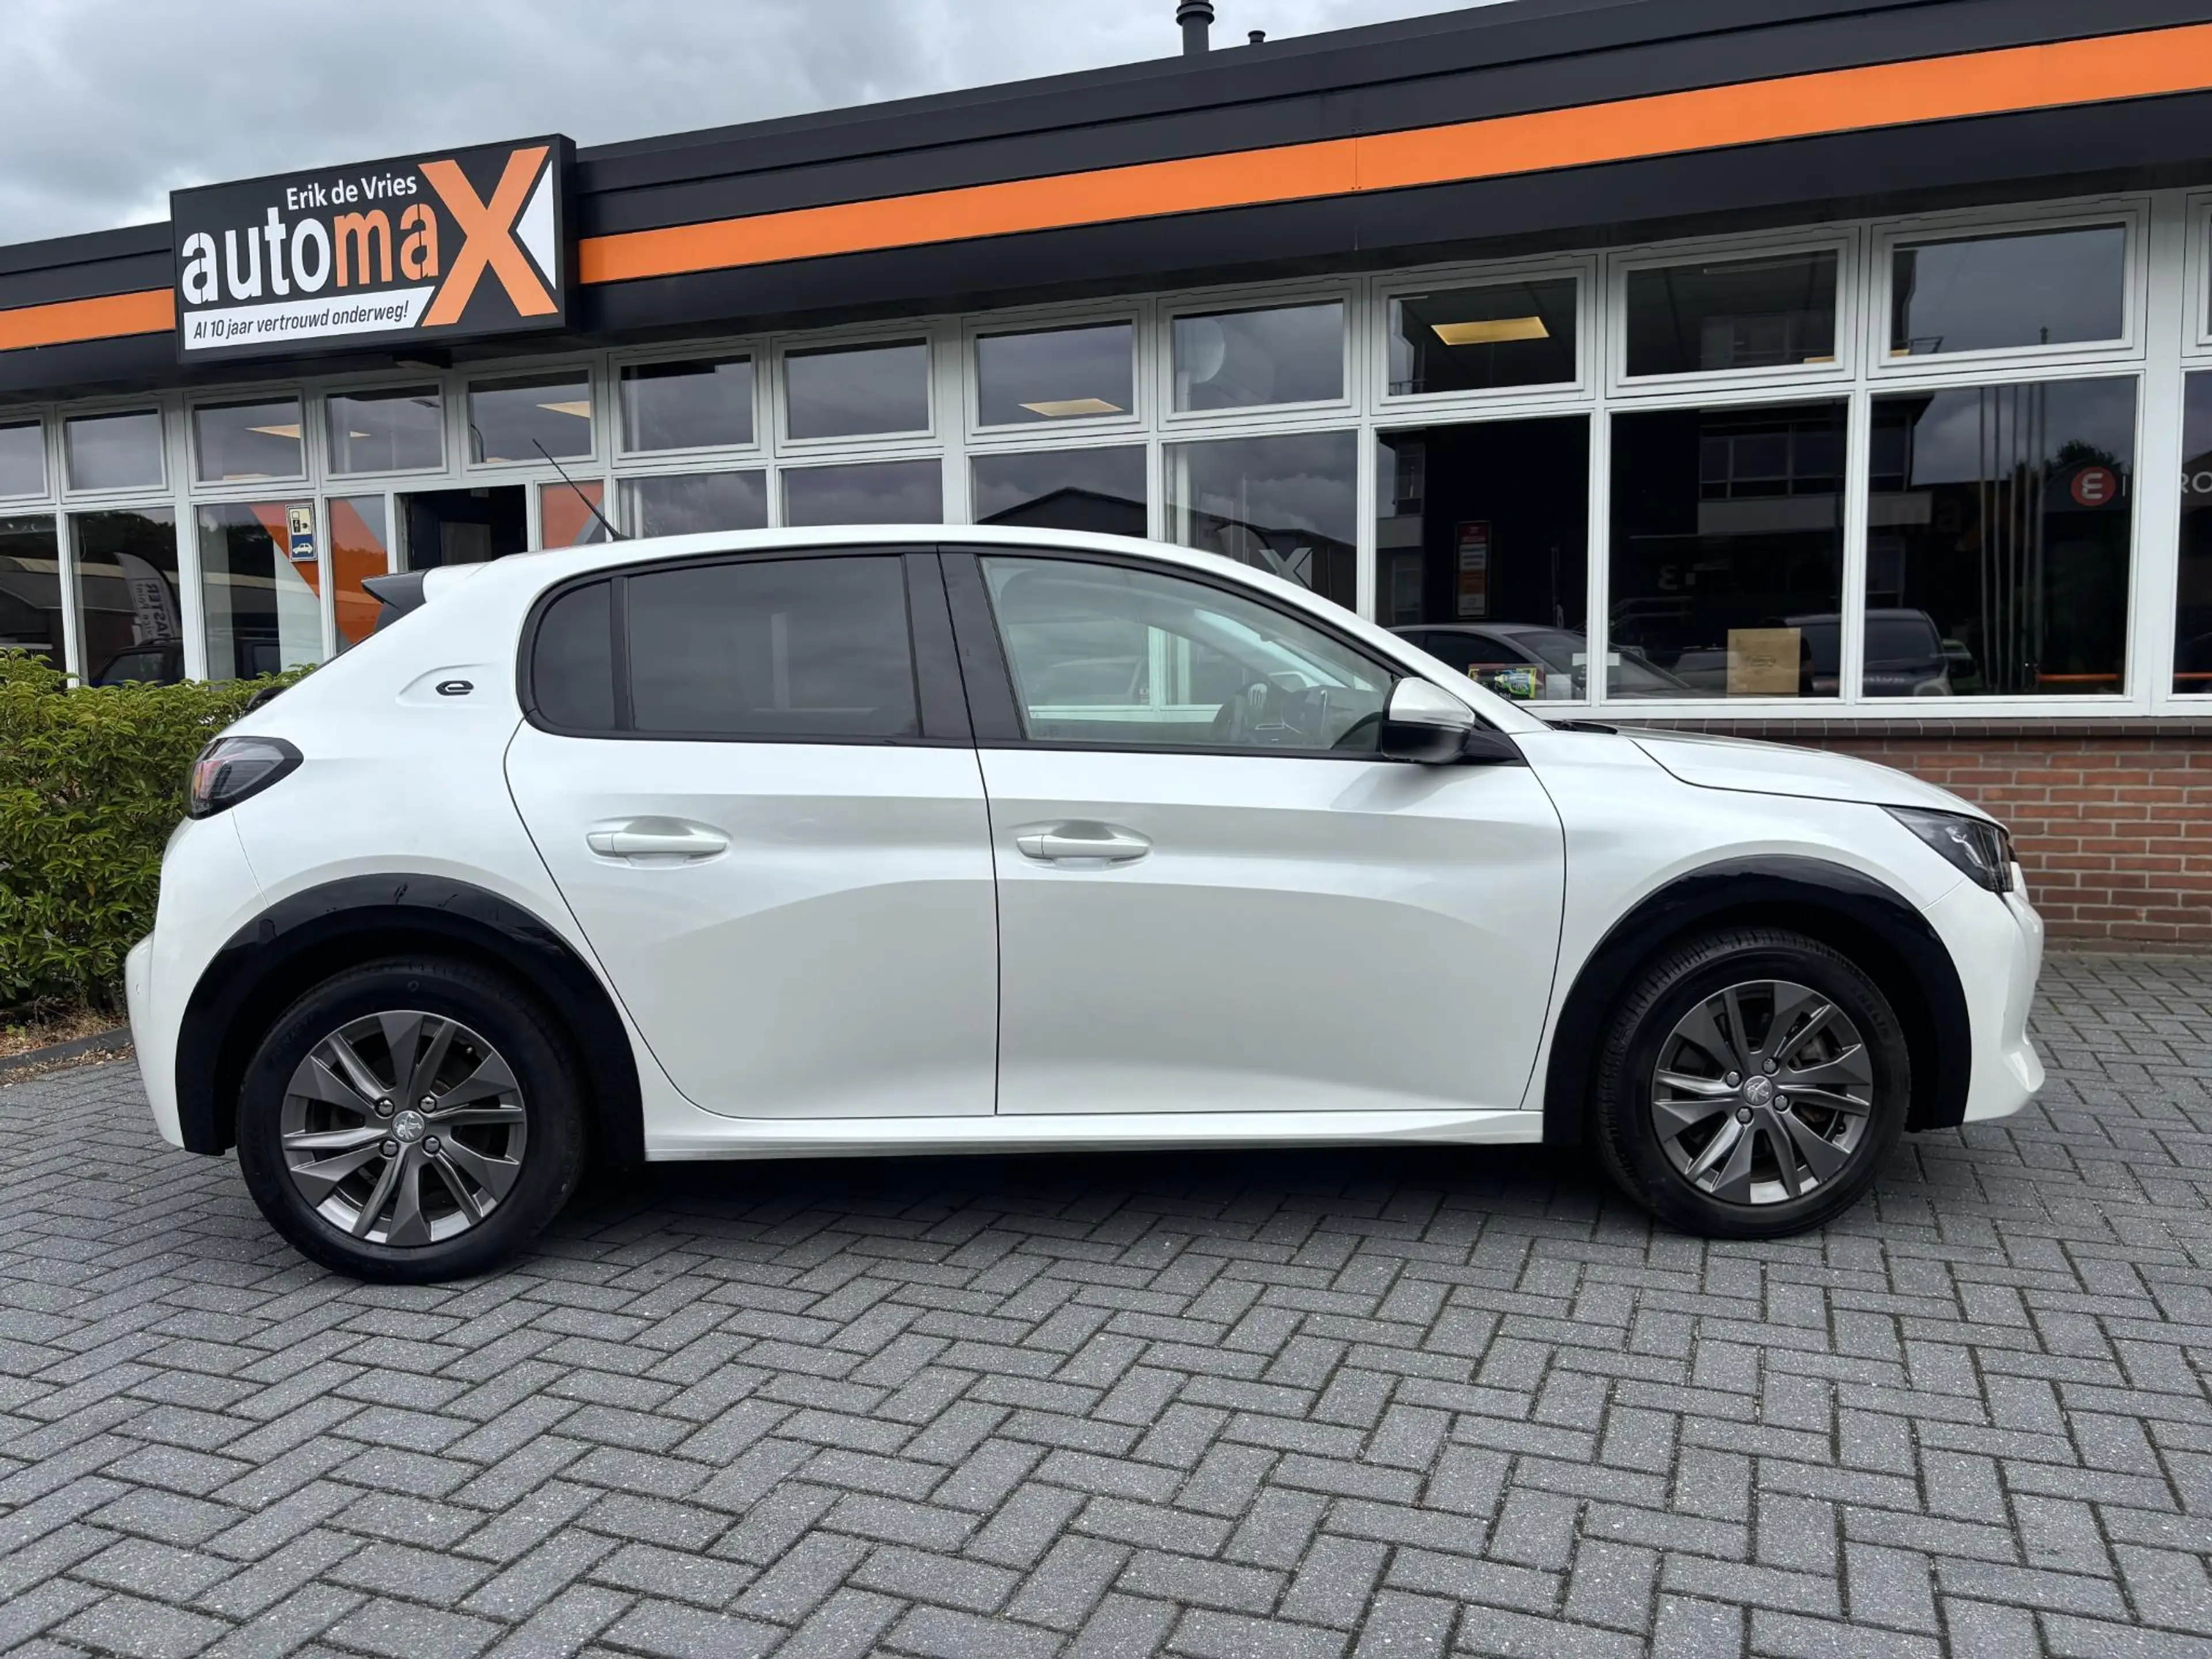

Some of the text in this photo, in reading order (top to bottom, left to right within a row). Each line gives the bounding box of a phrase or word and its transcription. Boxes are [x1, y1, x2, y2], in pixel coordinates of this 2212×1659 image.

[286, 173, 417, 211] Erik de Vries
[194, 300, 410, 339] Al 10 jaar vertrouwd onderweg!
